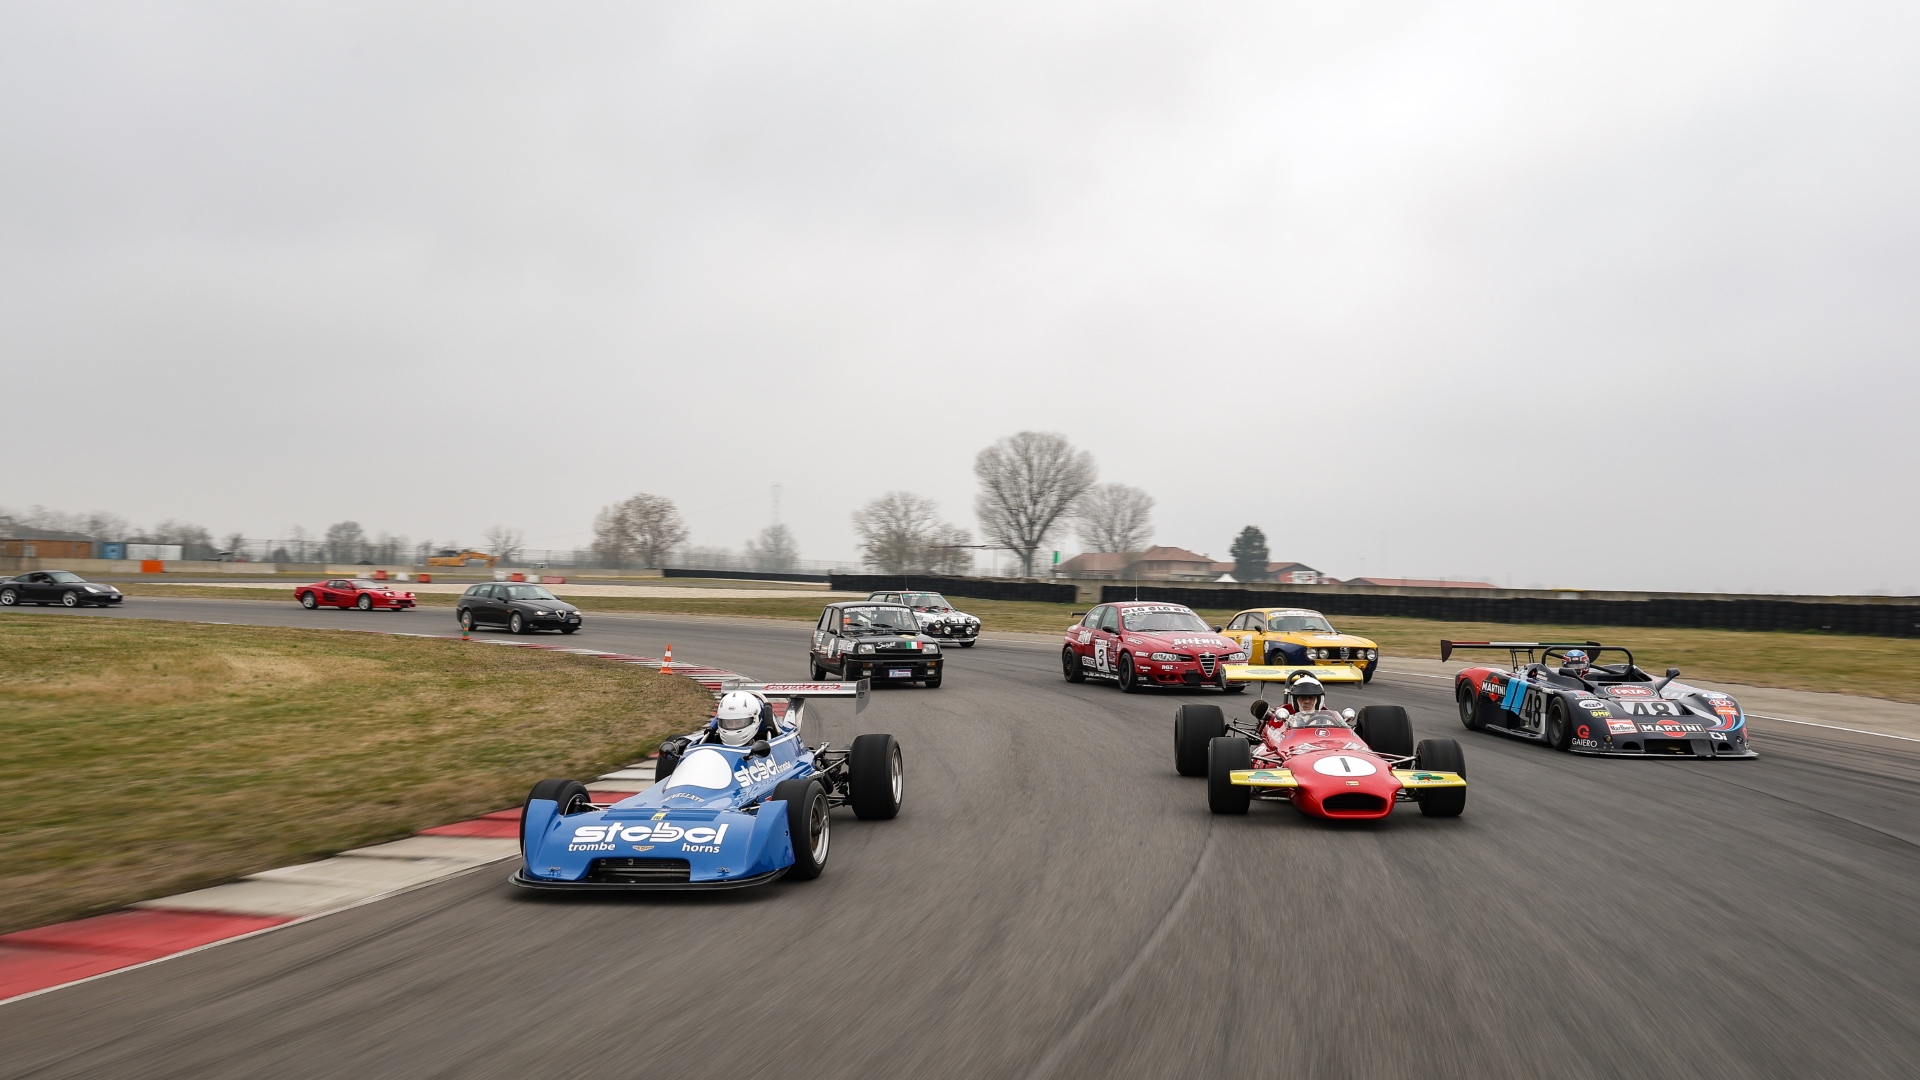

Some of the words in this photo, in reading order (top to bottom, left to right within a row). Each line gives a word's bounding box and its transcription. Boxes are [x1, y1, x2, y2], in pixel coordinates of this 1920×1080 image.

[1243, 641, 1250, 650] 22
[1098, 649, 1105, 667] 3
[1481, 681, 1506, 696] MARTINI
[1525, 693, 1542, 729] 48
[1609, 723, 1635, 732] Marlboro
[1641, 724, 1702, 732] MARTINI
[1571, 737, 1598, 748] GAIERO
[734, 754, 779, 788] stebel
[1339, 757, 1352, 773] 1
[571, 822, 729, 845] stebel
[568, 842, 616, 852] trombe
[681, 842, 720, 854] horns
